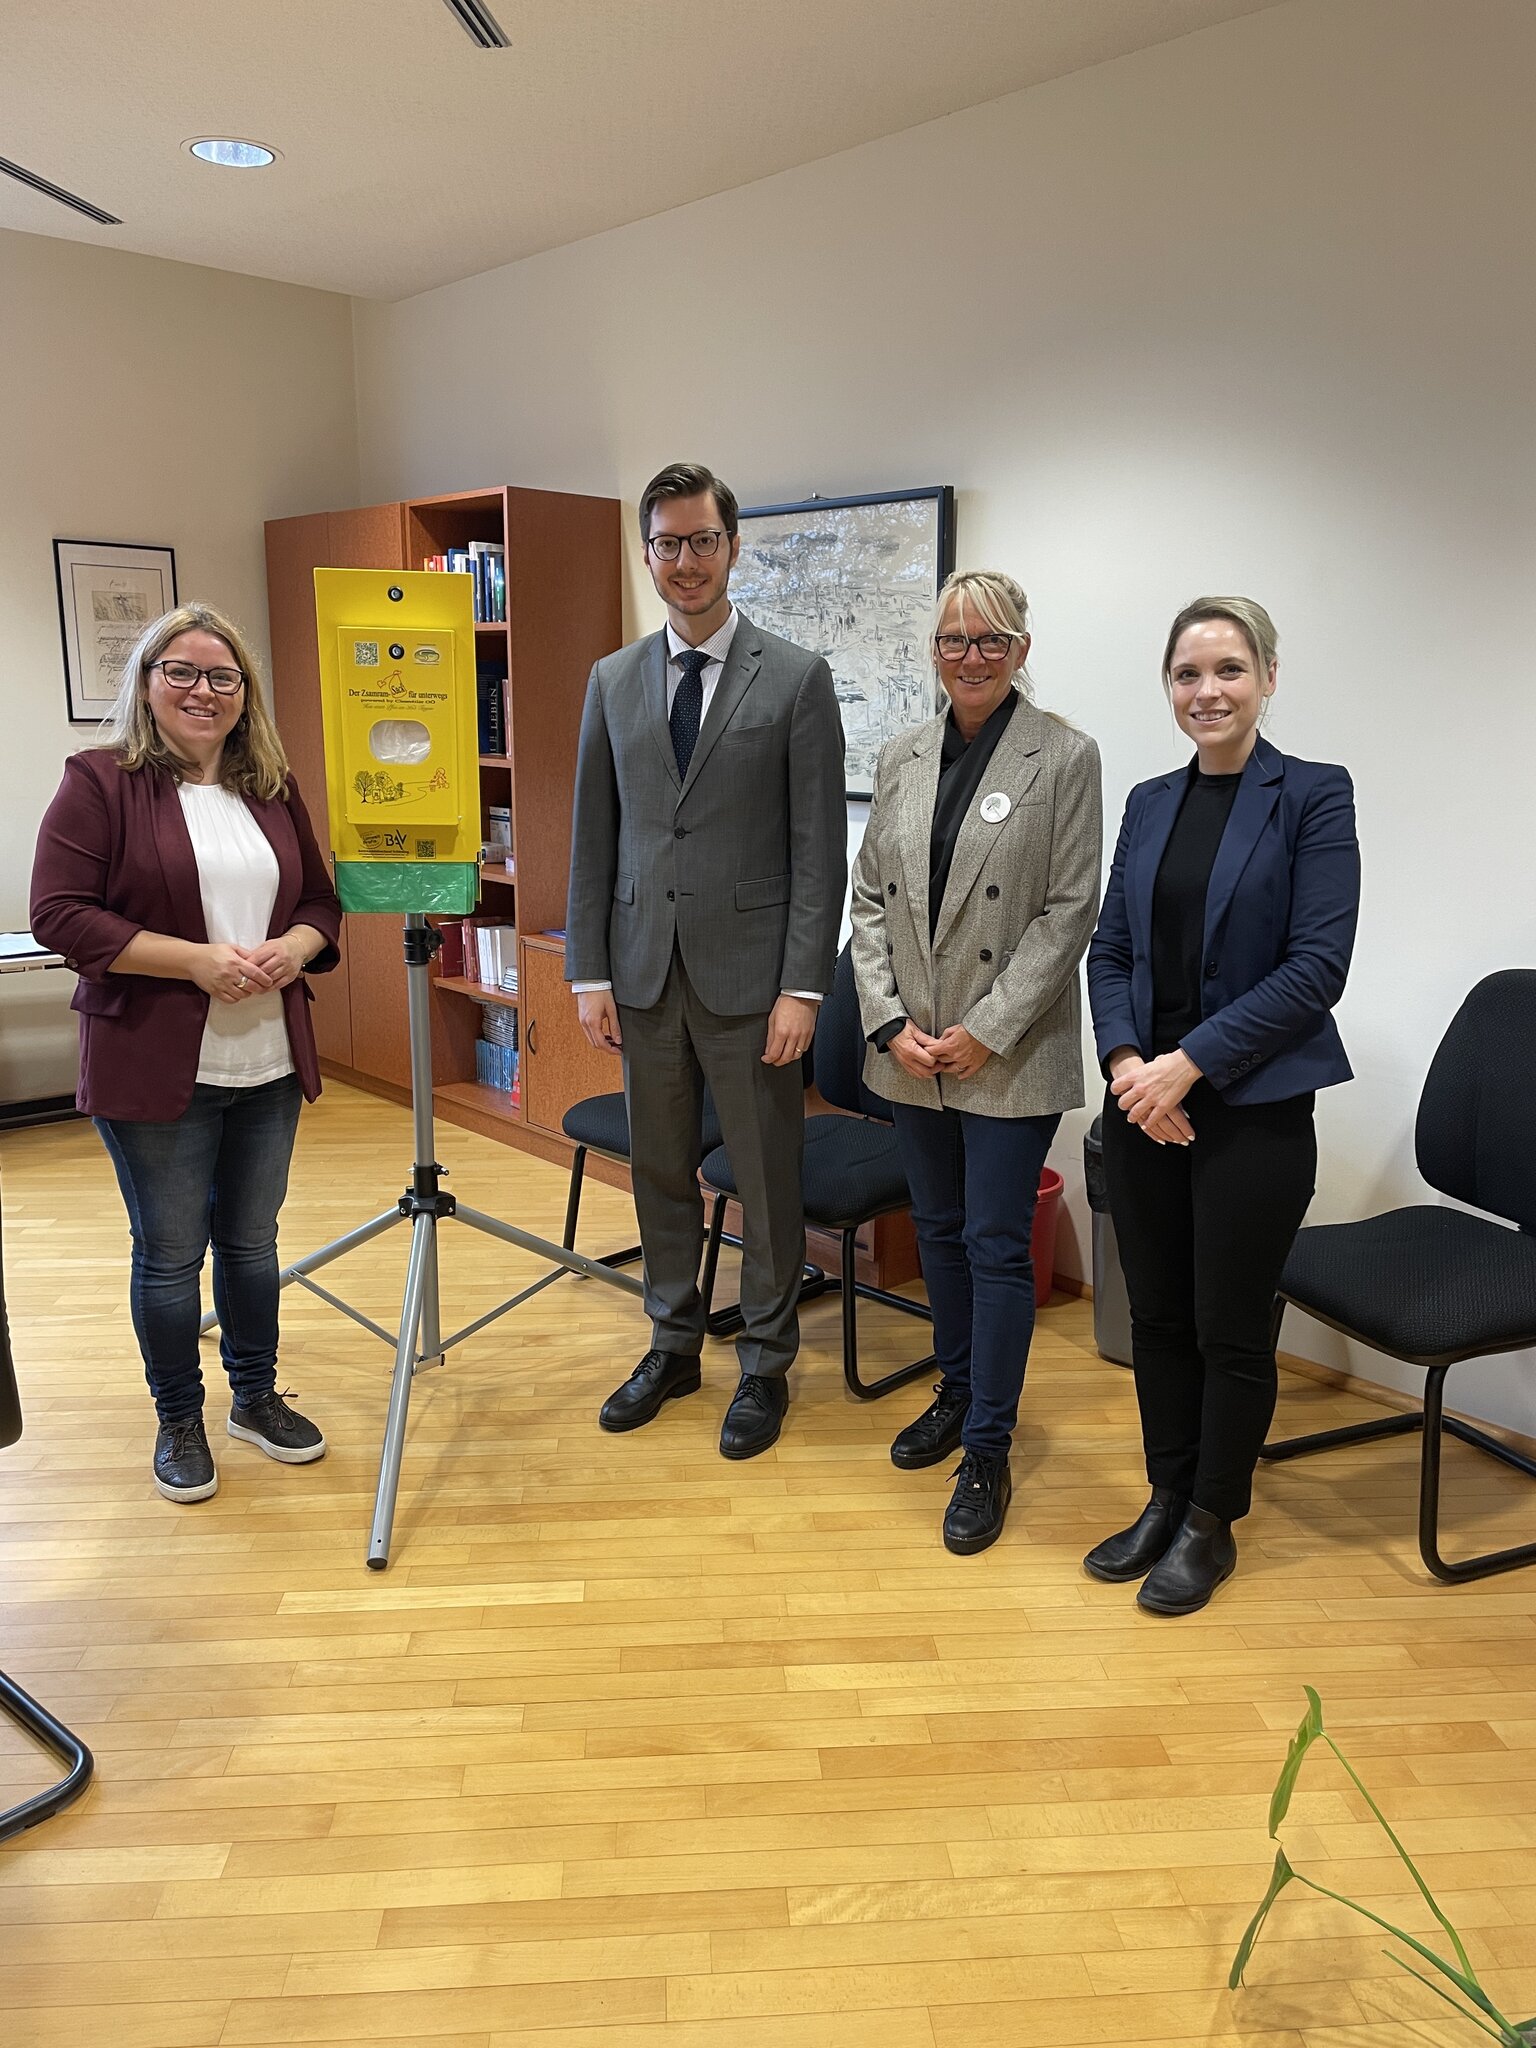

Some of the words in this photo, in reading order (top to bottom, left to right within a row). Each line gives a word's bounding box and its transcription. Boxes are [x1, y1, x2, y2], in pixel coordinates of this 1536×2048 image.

[348, 688, 360, 697] Der
[408, 690, 418, 699] für
[418, 692, 448, 701] unterwegs
[490, 688, 498, 729] LEBEN
[384, 829, 407, 850] BAV
